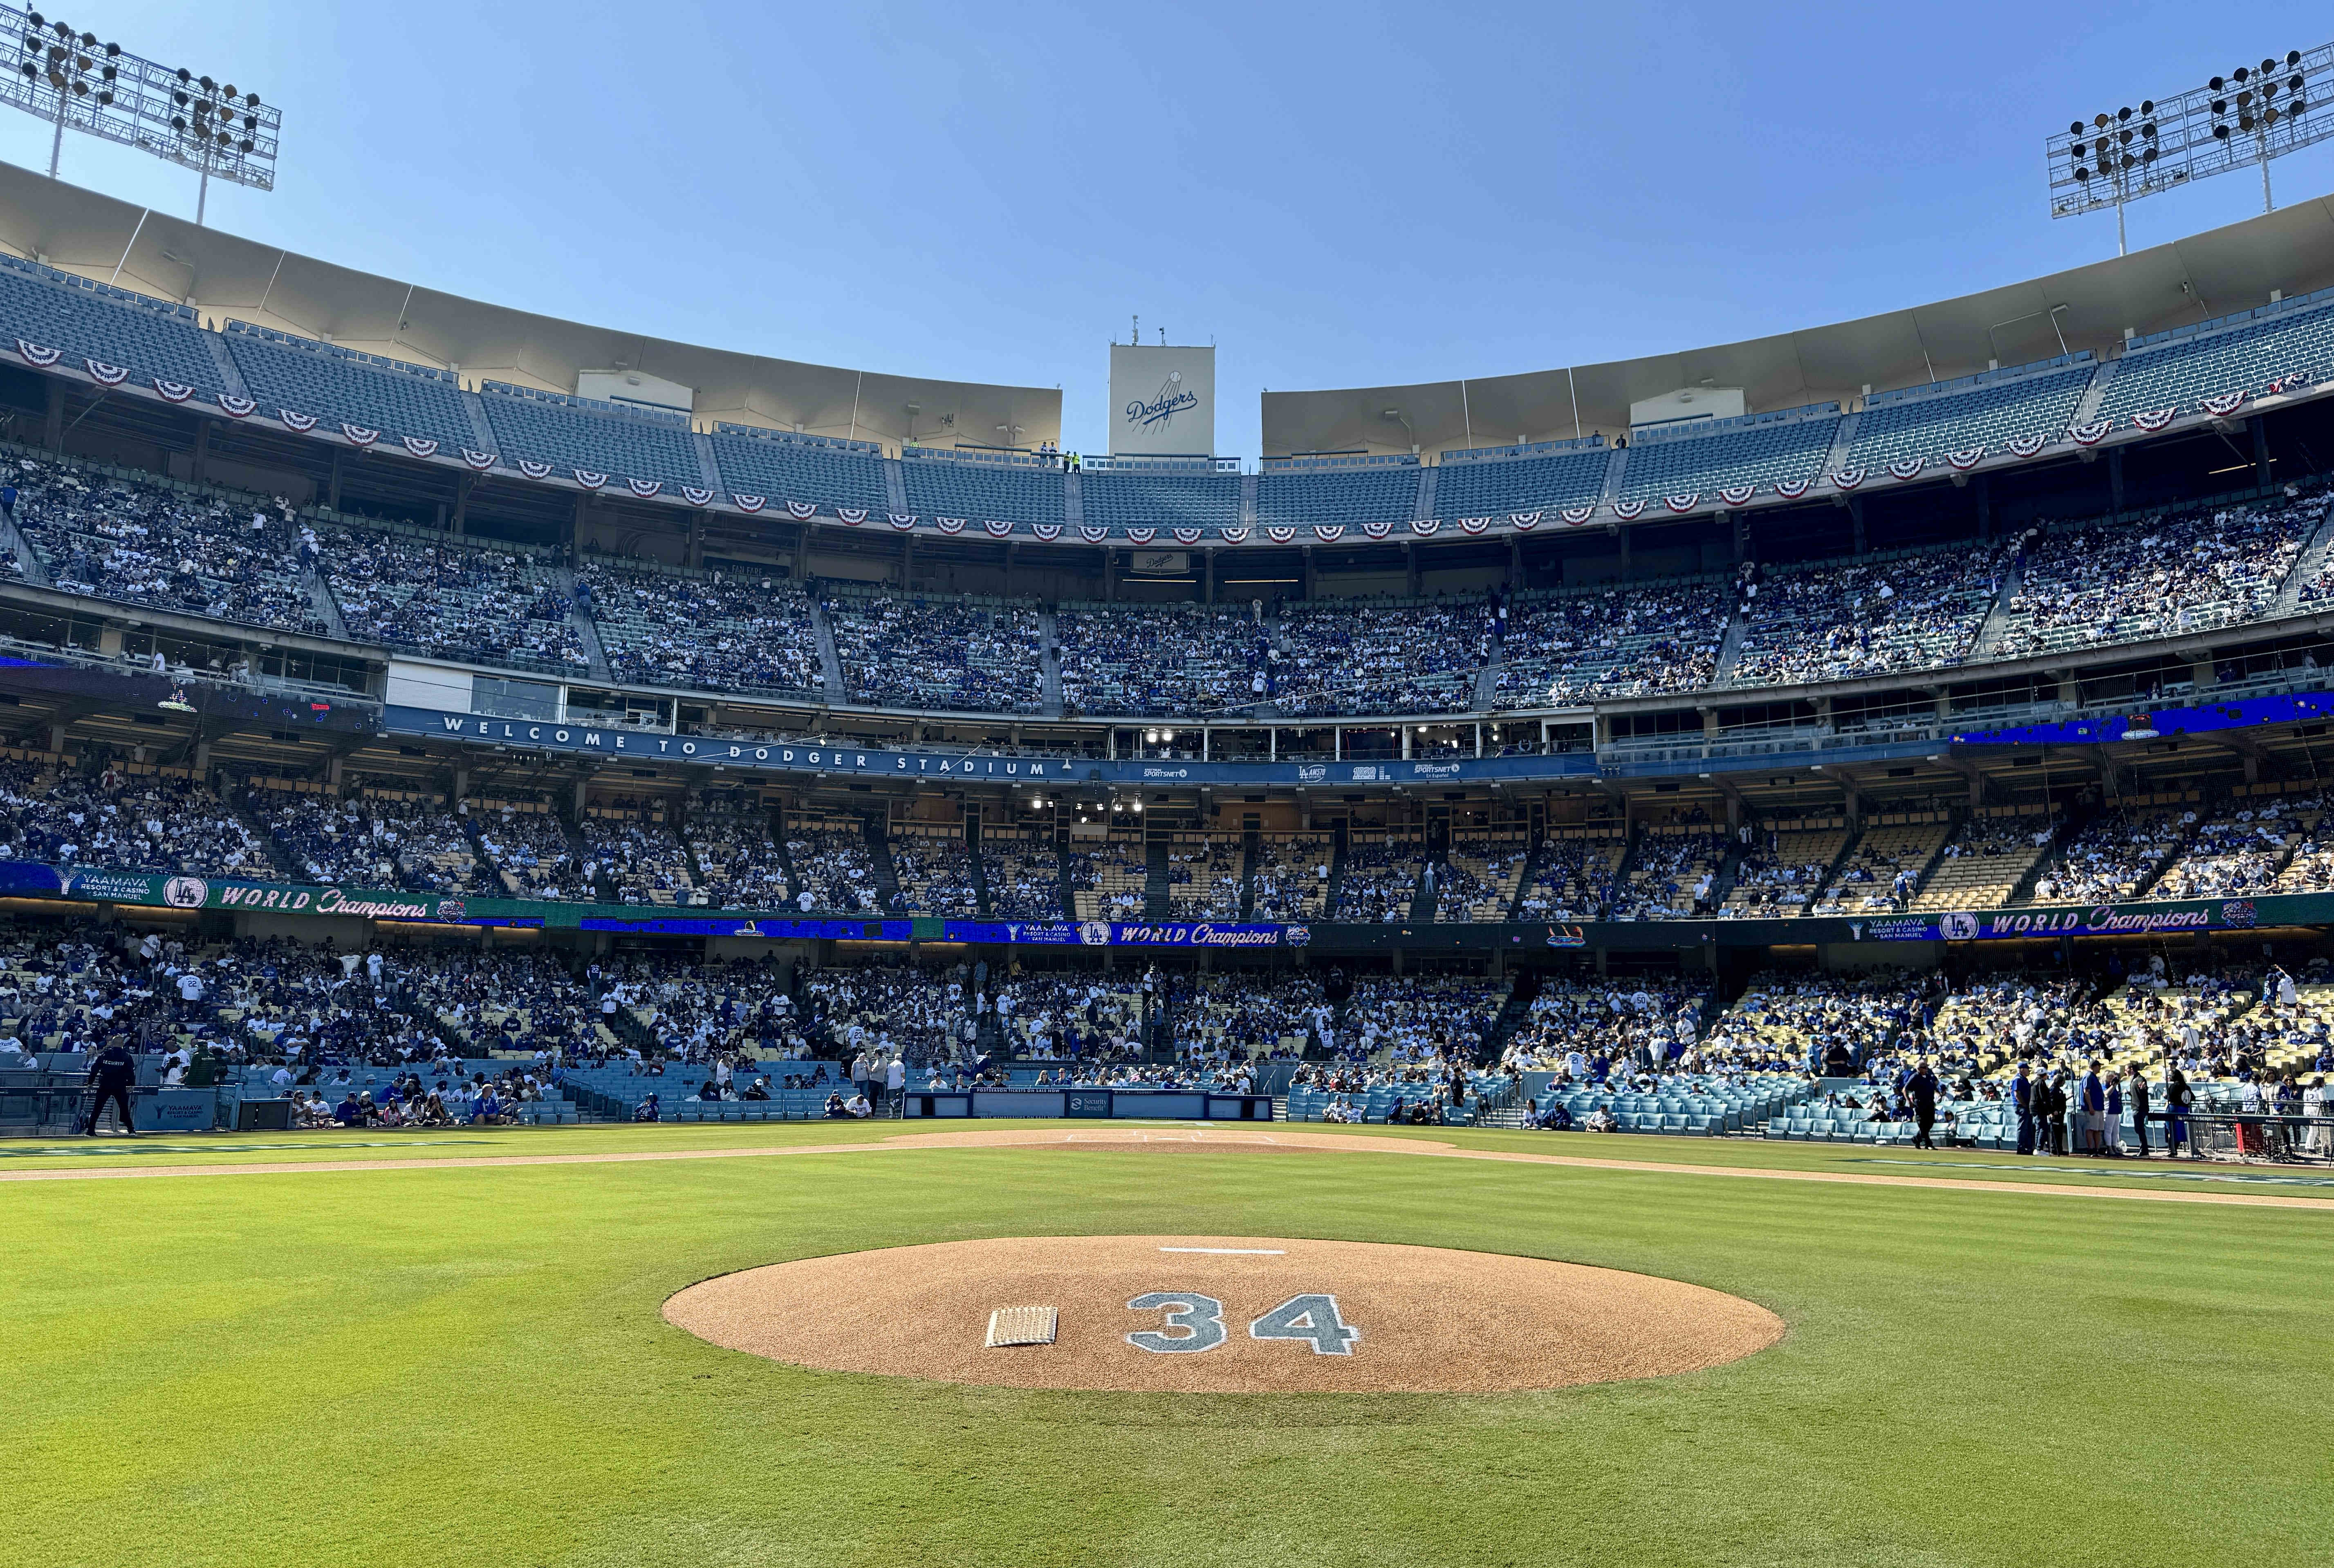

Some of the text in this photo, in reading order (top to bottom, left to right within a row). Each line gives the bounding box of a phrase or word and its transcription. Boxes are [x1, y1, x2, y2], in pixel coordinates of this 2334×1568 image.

[1127, 391, 1197, 426] Dodgers
[732, 565, 744, 573] FAN
[747, 567, 762, 576] FARE
[1146, 553, 1173, 568] Dodgers
[444, 716, 1044, 775] WELCOME TO DODGER STADIUM
[1299, 766, 1308, 779] LA
[1354, 767, 1376, 776] 1020
[111, 892, 143, 900] MANUEL
[221, 886, 310, 909] WORLD
[316, 889, 428, 918] Champions
[1950, 915, 1970, 936] LA
[1993, 913, 2078, 933] WORLD
[2089, 906, 2209, 932] Champions
[1089, 923, 1102, 943] LA
[1121, 927, 1186, 942] WORLD
[1191, 923, 1278, 948] Champions
[1323, 1033, 1330, 1042] 17
[1084, 1098, 1107, 1106] Security
[1125, 1290, 1361, 1356] 34
